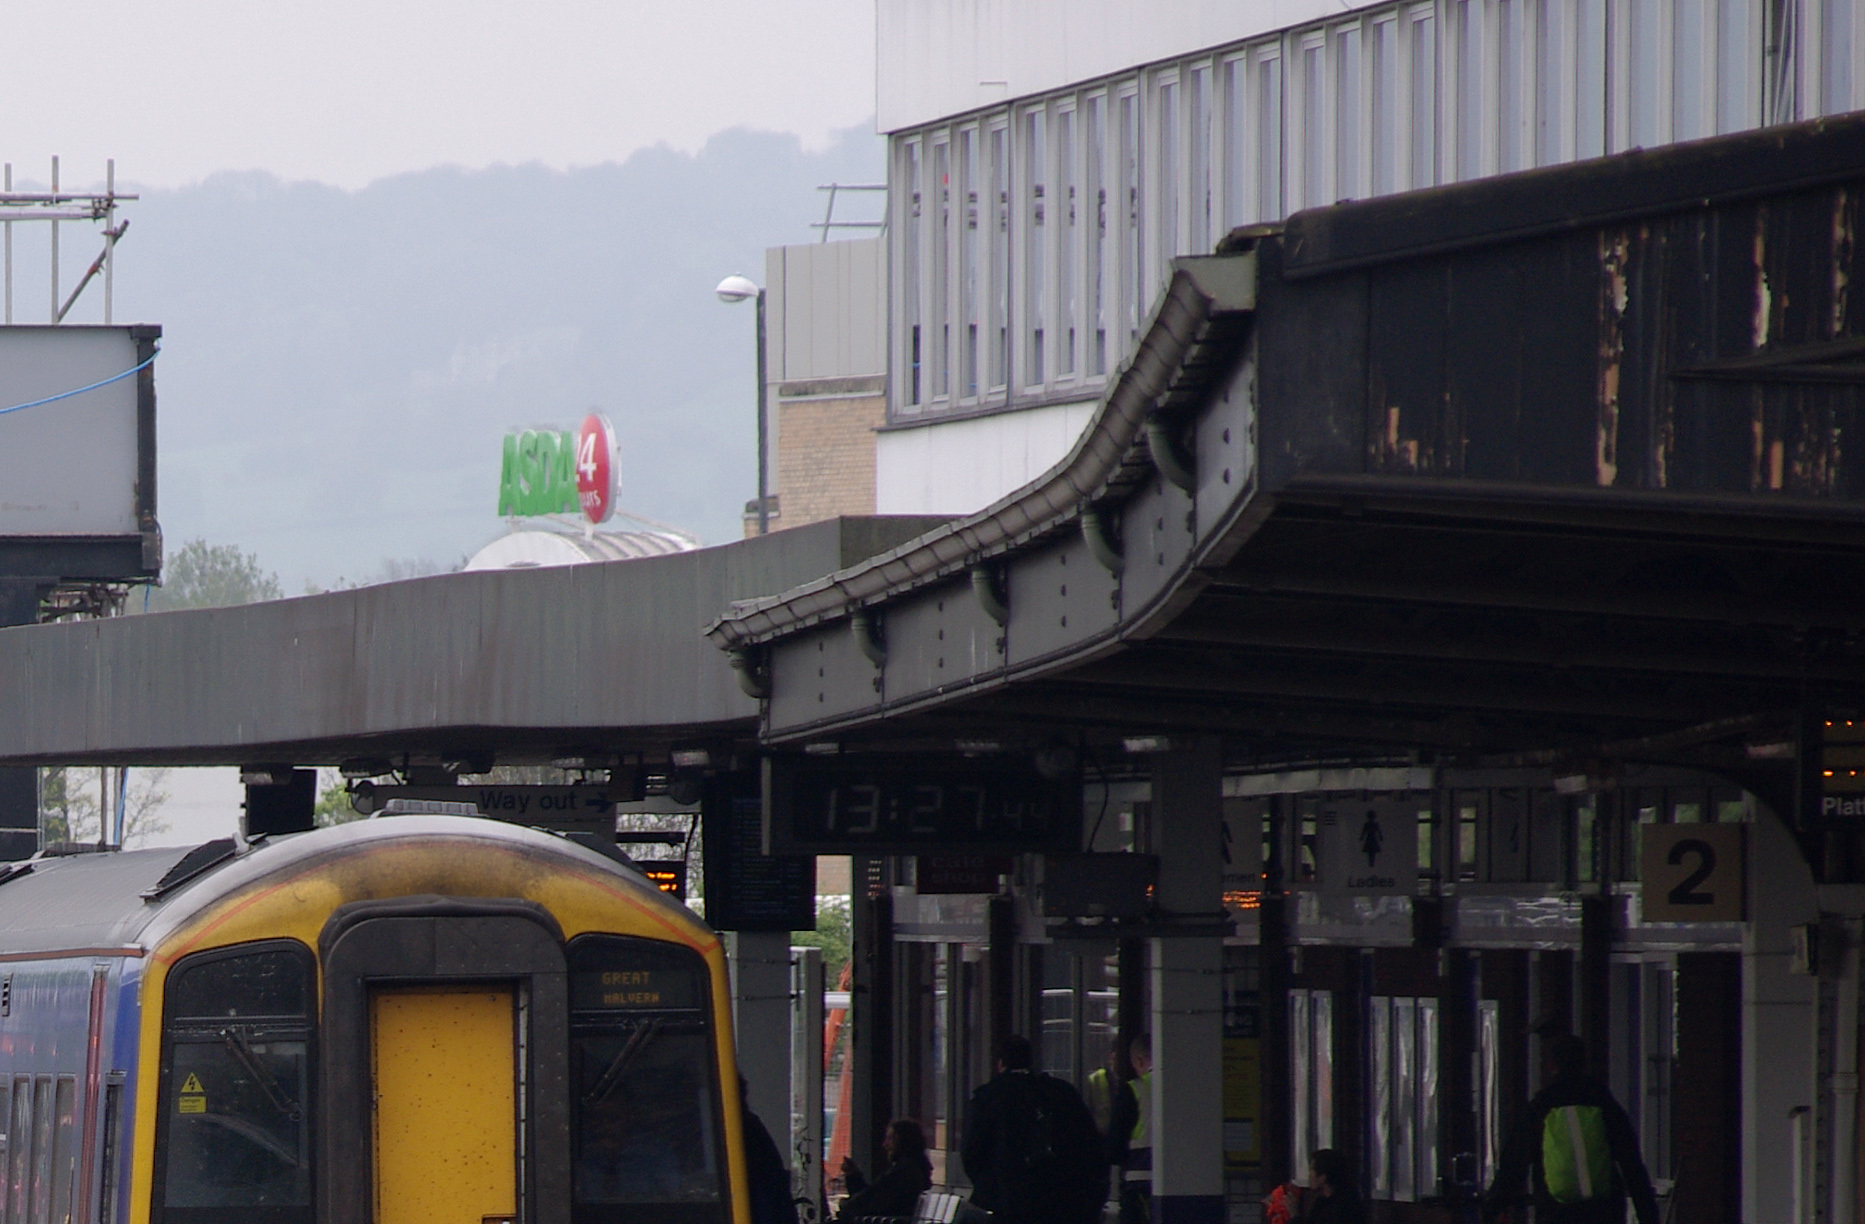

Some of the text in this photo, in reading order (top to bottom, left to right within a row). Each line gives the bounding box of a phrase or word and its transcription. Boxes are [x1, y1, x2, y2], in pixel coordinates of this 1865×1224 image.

[498, 429, 580, 517] ASDA
[480, 790, 578, 813] Way out
[1822, 796, 1865, 816] Plat
[1347, 875, 1396, 888] Ladies
[1668, 838, 1716, 905] 2
[601, 971, 650, 985] GREAT
[603, 992, 660, 1005] MALVERN
